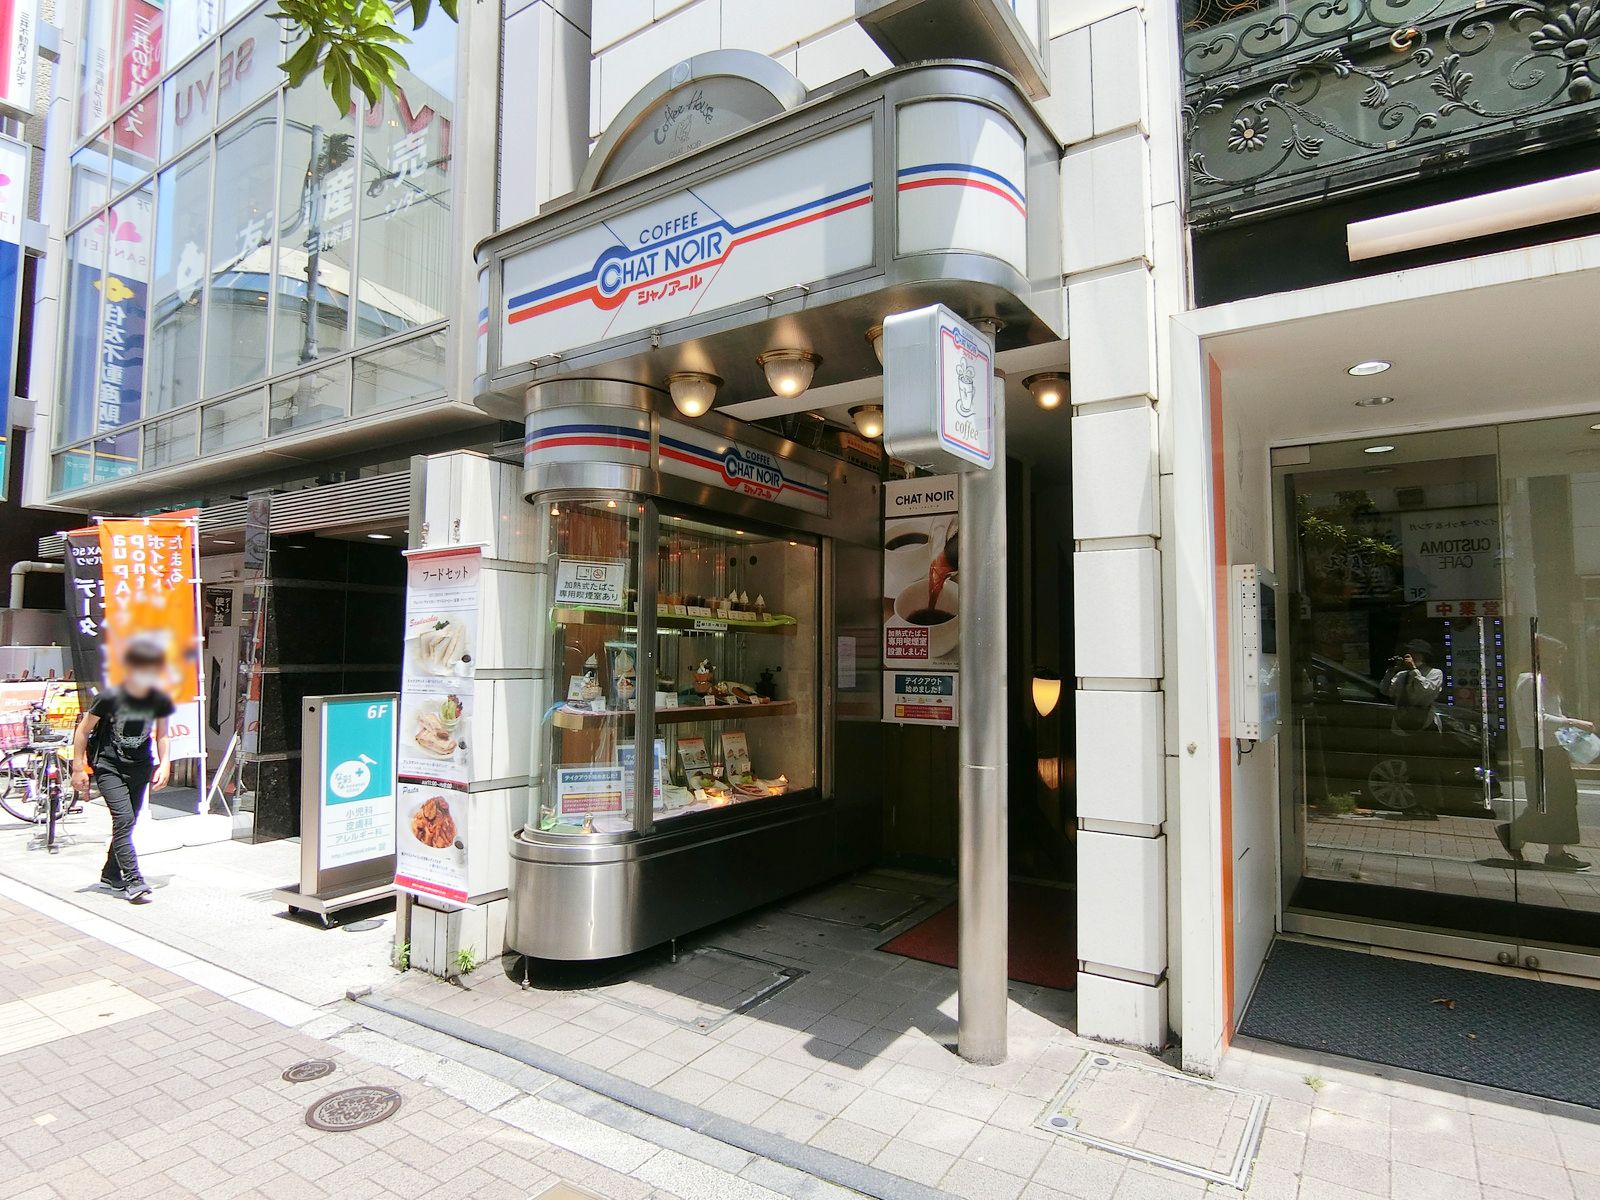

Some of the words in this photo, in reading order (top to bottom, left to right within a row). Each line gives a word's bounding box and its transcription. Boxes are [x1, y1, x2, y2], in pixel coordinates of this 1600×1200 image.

[639, 211, 699, 245] COFFEE
[600, 253, 655, 294] CHAT
[664, 231, 722, 272] NOIR
[637, 274, 702, 305] シャノアール
[954, 420, 979, 441] coffee
[745, 450, 770, 466] COFFEE
[726, 455, 756, 481] CHAT
[756, 467, 780, 488] NOIR
[895, 493, 922, 506] CHAT
[925, 490, 954, 503] NOIR
[422, 566, 469, 583] フードセット
[564, 581, 615, 592] 加熱式たばこ
[559, 589, 619, 602] 専用喫煙室あり
[888, 629, 927, 637] 加熱式たばこ
[888, 637, 927, 646] 専用喫煙室
[888, 647, 927, 656] 設置しました
[905, 677, 942, 685] テイクアウト
[905, 685, 941, 694] 始めました!
[367, 704, 388, 720] 6F
[345, 805, 373, 819] 小児科
[345, 817, 373, 831] 皮膚科
[336, 828, 383, 844] アレルギー科
